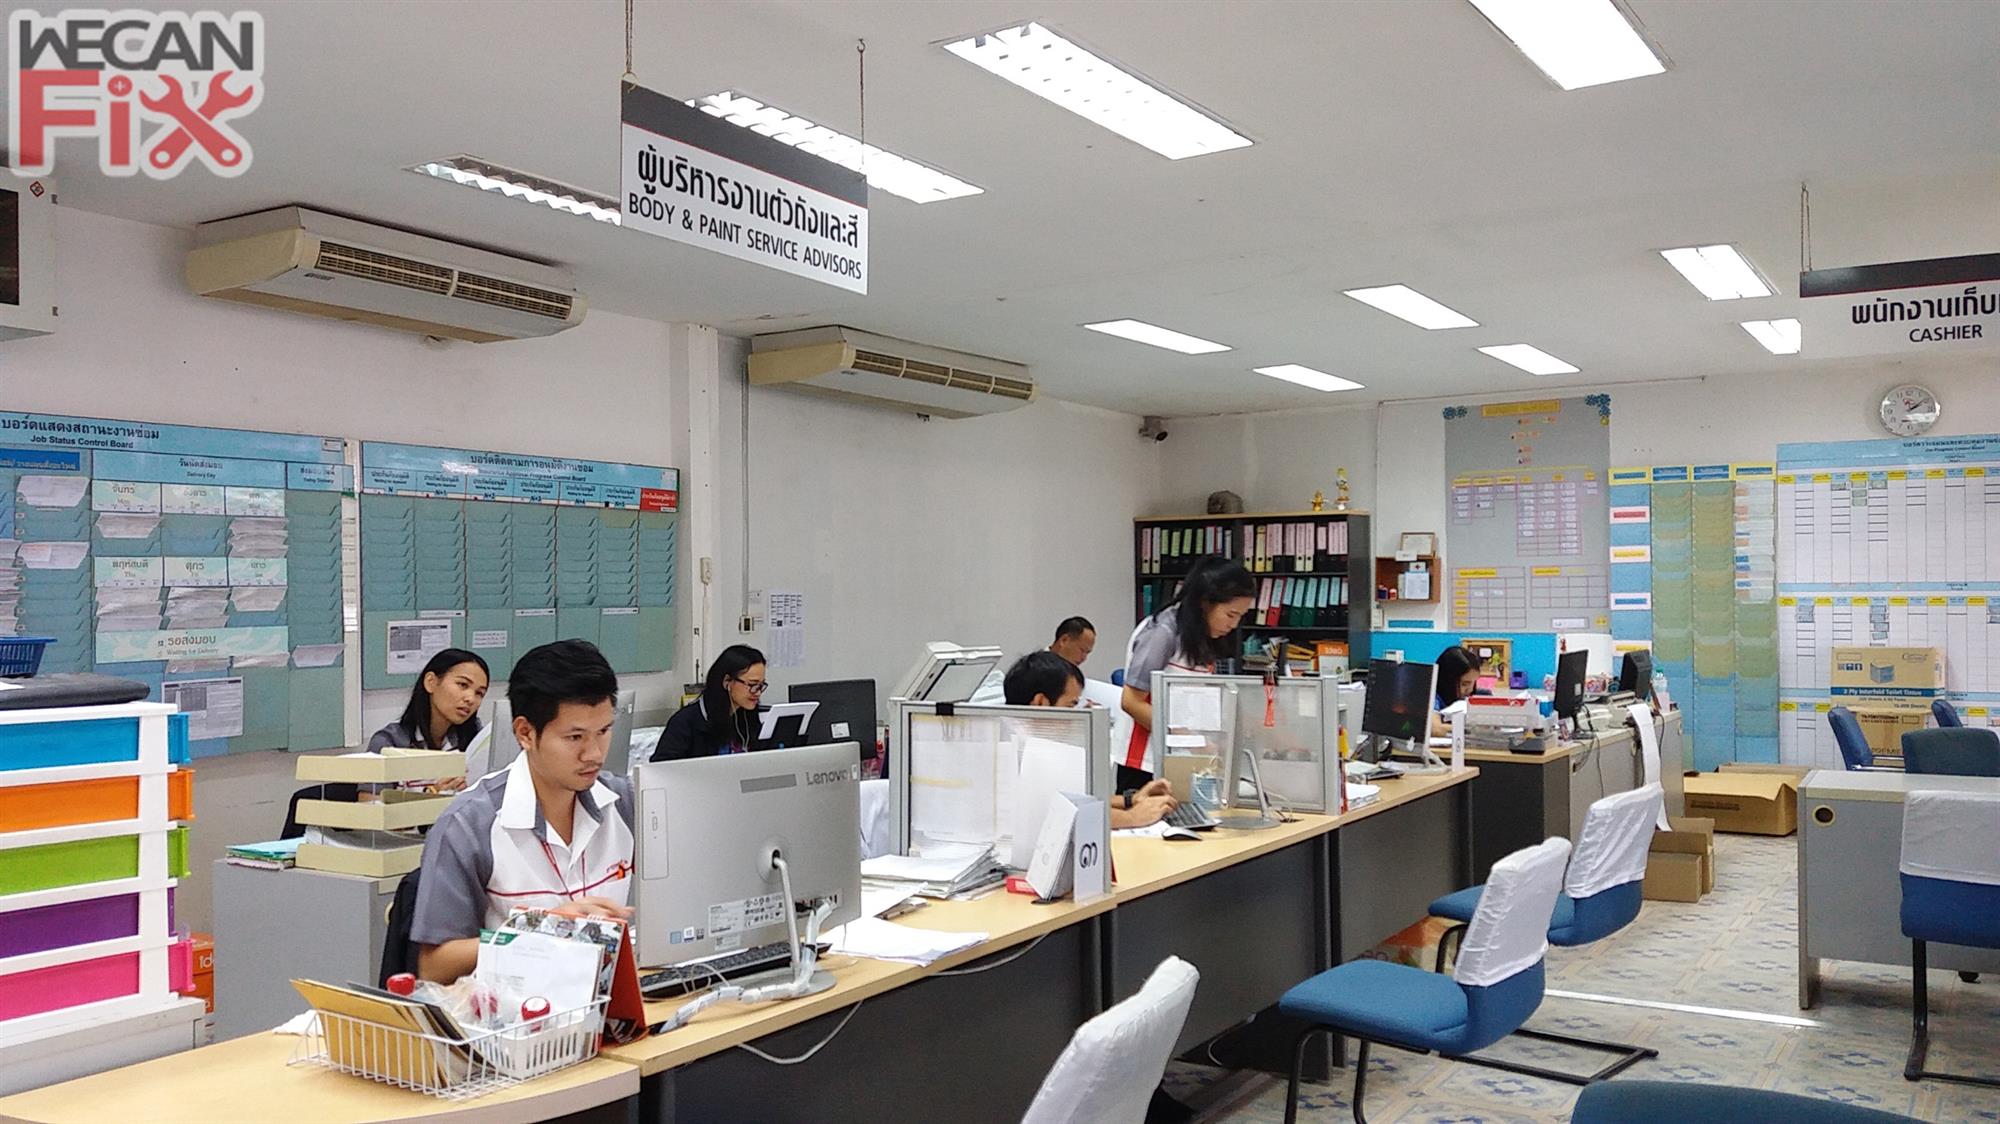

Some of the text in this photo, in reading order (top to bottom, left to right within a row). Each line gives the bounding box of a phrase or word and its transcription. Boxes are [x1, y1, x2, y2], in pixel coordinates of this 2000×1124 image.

[638, 144, 858, 248] ผู้บริหารงานตัวถังและสี
[629, 192, 862, 279] BODY & PAINT SERVICE ADVISORS
[1910, 324, 1982, 342] CASHIER
[1, 416, 160, 439] บอร์ดแสดงสถานะงานซ่อม
[30, 435, 134, 448] Job Status Control Board
[168, 632, 216, 646] รอส่งมอบ
[806, 770, 848, 786] Lenovo
